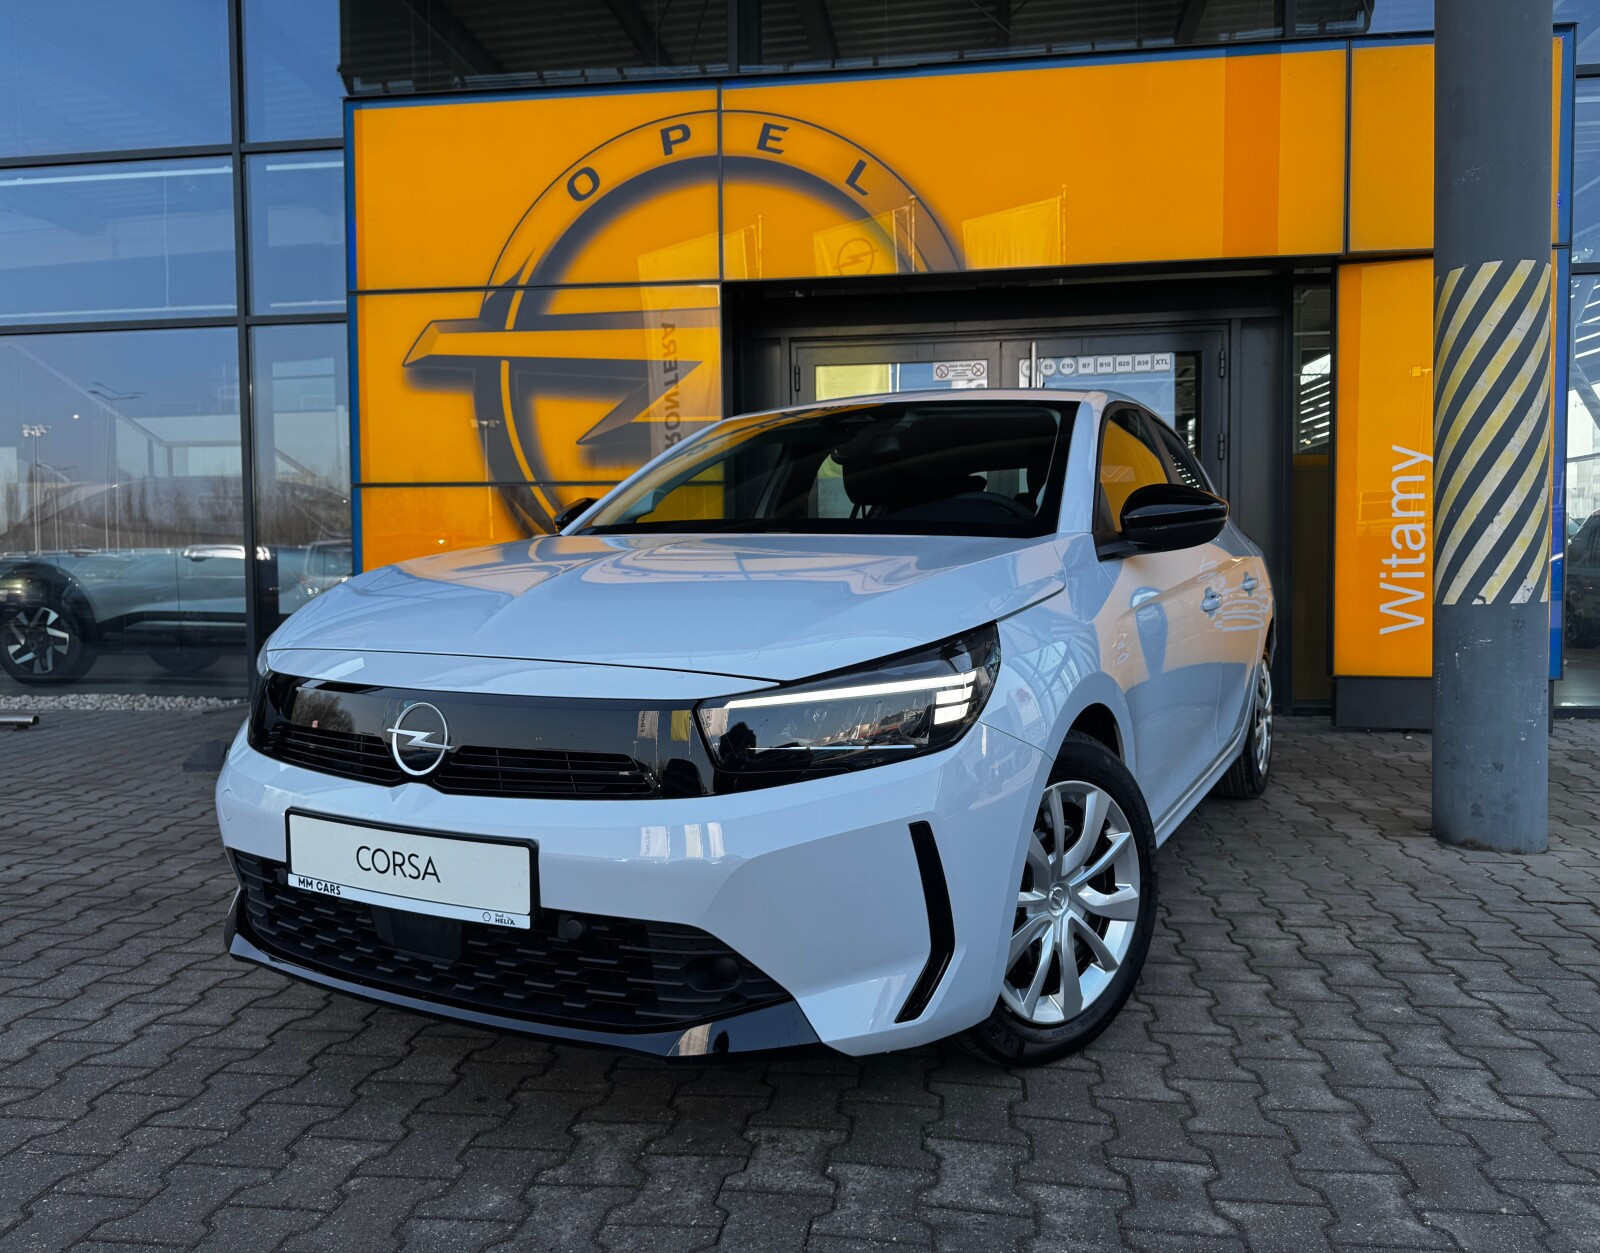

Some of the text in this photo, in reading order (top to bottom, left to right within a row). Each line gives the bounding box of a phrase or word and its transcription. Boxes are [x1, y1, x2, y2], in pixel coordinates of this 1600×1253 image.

[566, 122, 869, 202] OPEL
[1155, 358, 1169, 366] XTL
[1379, 444, 1433, 635] Witamy
[356, 845, 441, 884] CORSA
[298, 877, 341, 895] MM CARS
[494, 917, 515, 926] HELIX
